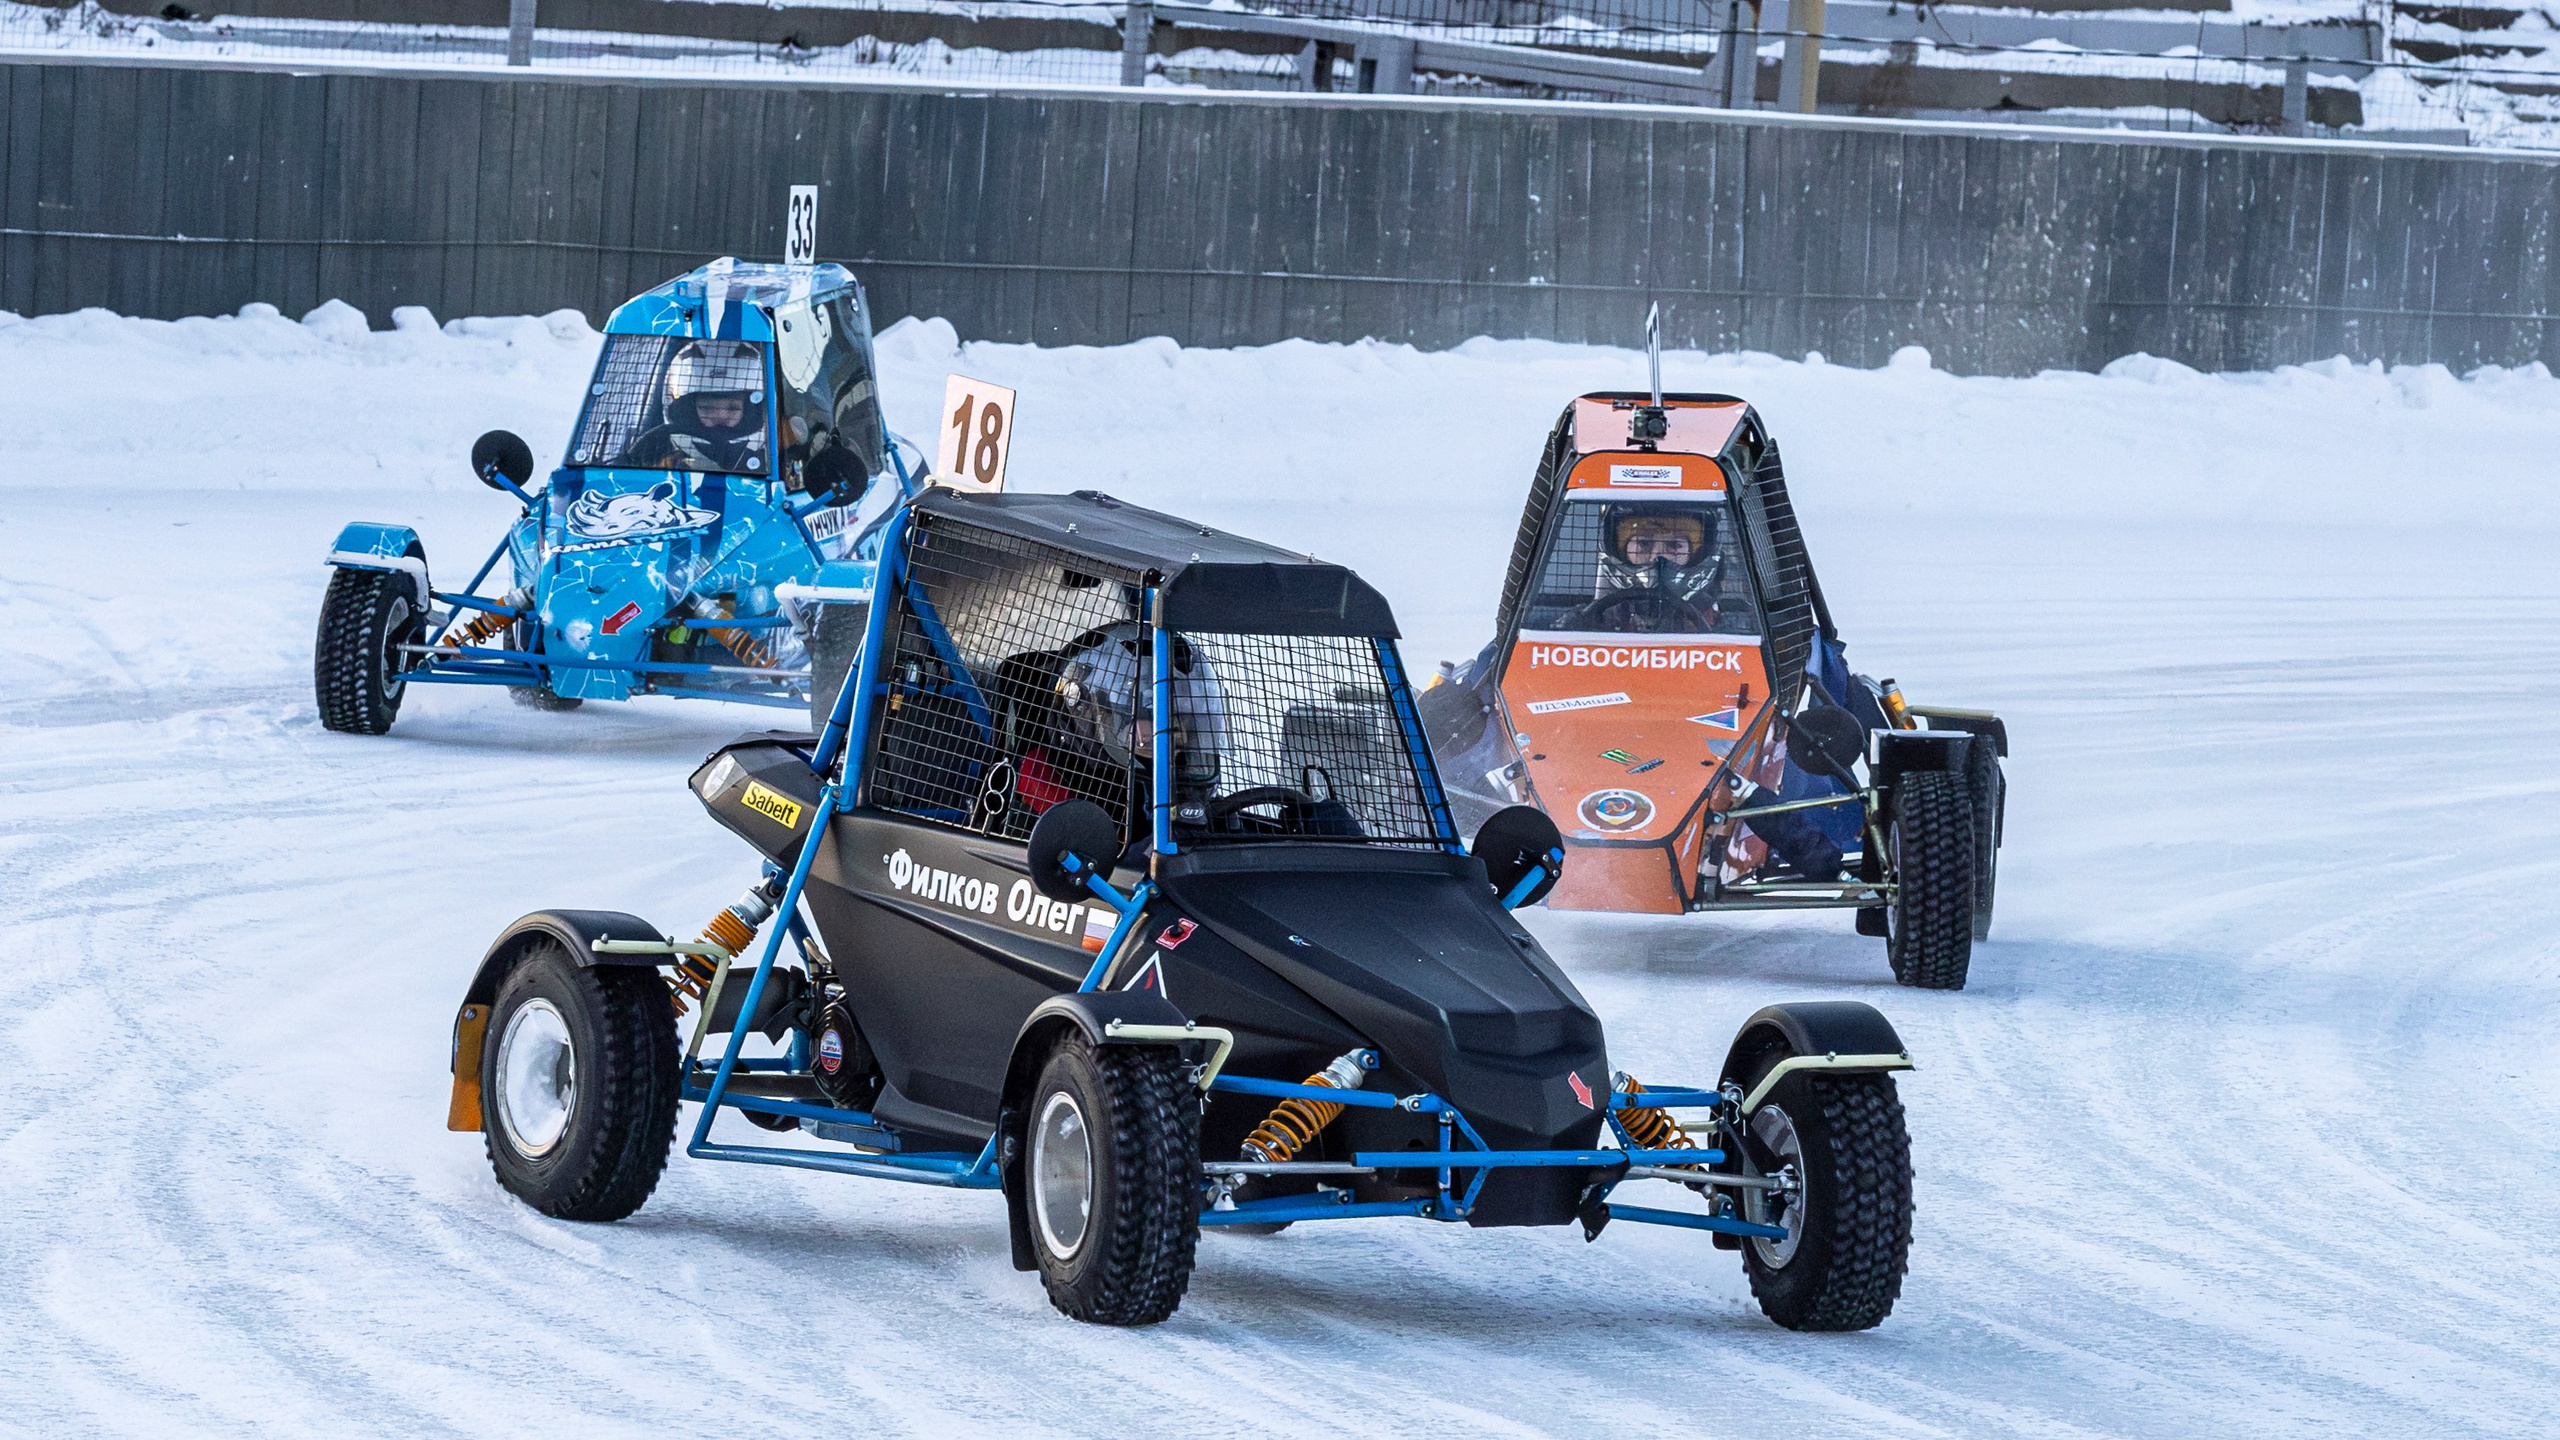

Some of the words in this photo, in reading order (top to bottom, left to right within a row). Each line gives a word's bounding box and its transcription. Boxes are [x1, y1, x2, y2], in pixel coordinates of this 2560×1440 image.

[791, 194, 813, 258] 33
[952, 393, 1004, 484] 18
[1532, 646, 1743, 671] НОВОСИБИРСК
[747, 785, 795, 824] Sabelt
[888, 848, 1000, 915] Филков
[1007, 878, 1085, 935] Олег
